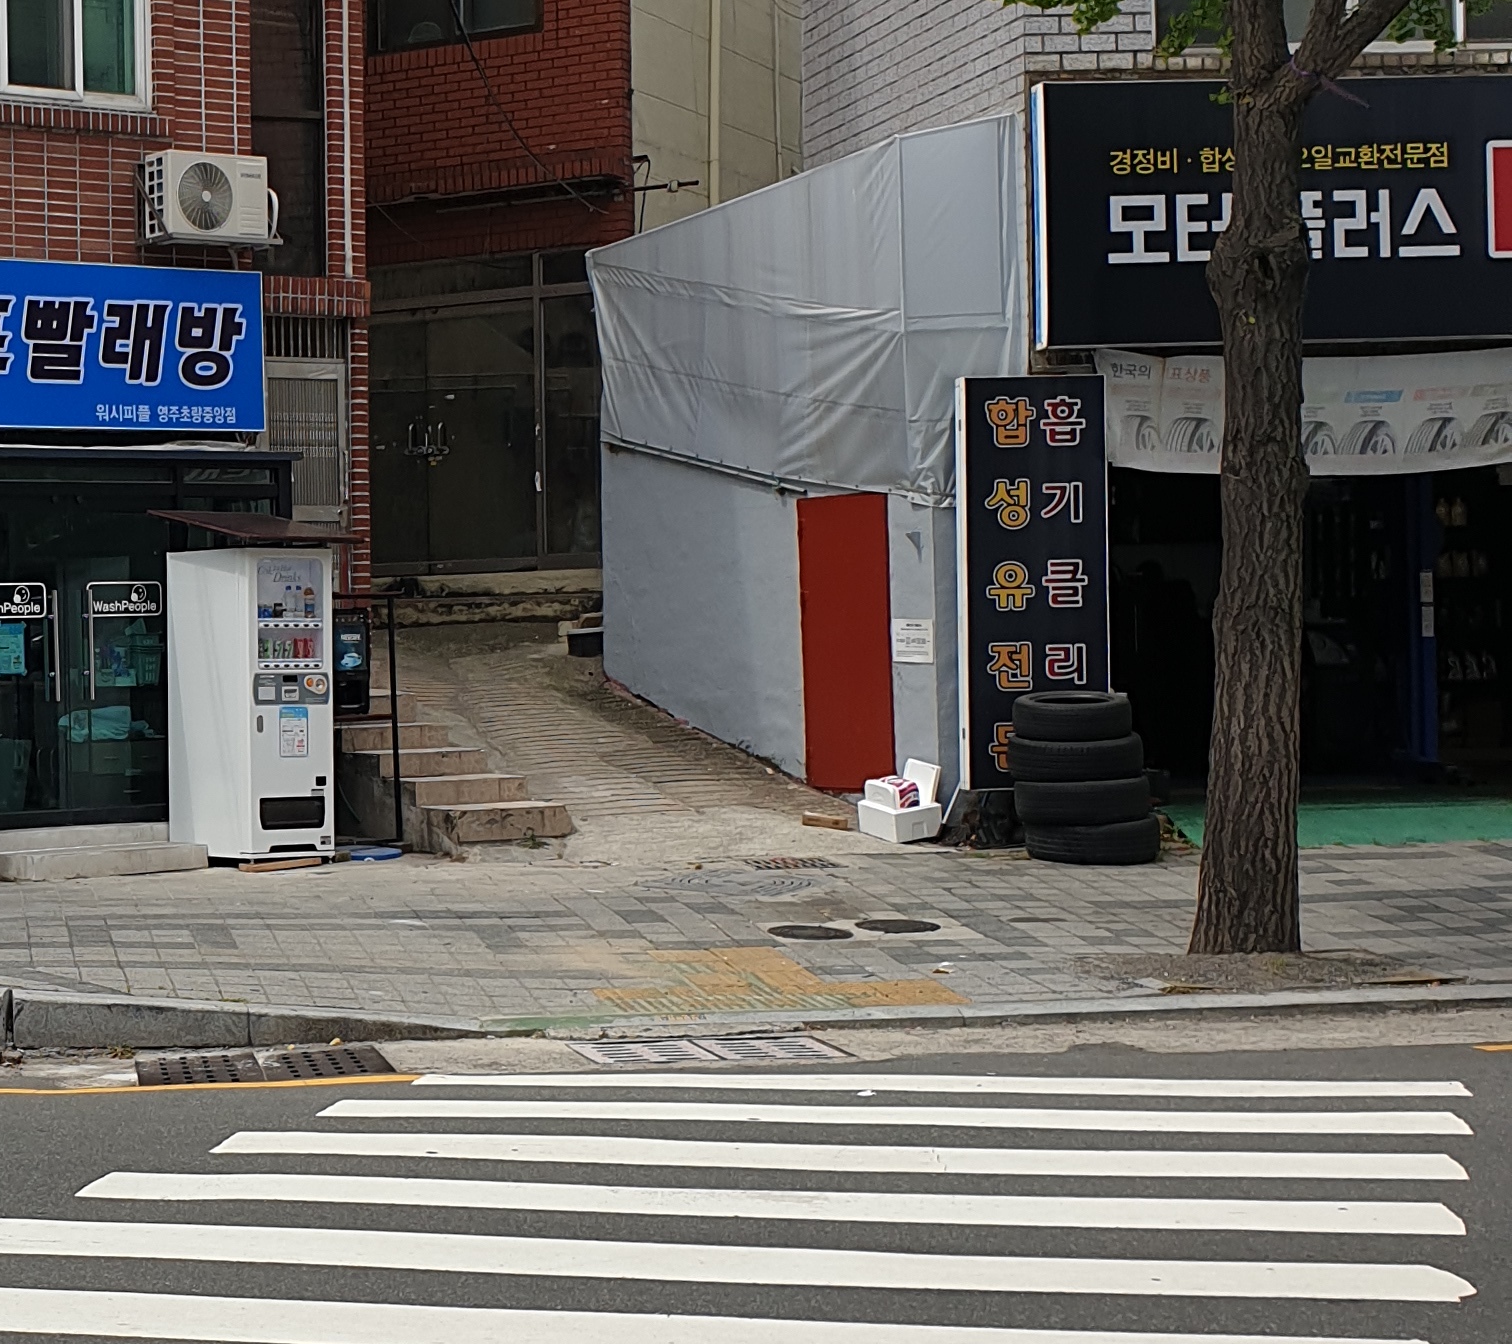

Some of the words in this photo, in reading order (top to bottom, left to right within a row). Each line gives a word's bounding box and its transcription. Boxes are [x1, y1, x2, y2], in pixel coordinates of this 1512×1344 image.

[1109, 147, 1179, 175] 경정비
[1111, 362, 1151, 379] 한국의
[95, 404, 151, 422] 워시피플
[157, 406, 236, 423] 영주초량중앙점
[92, 600, 157, 613] WashPeople
